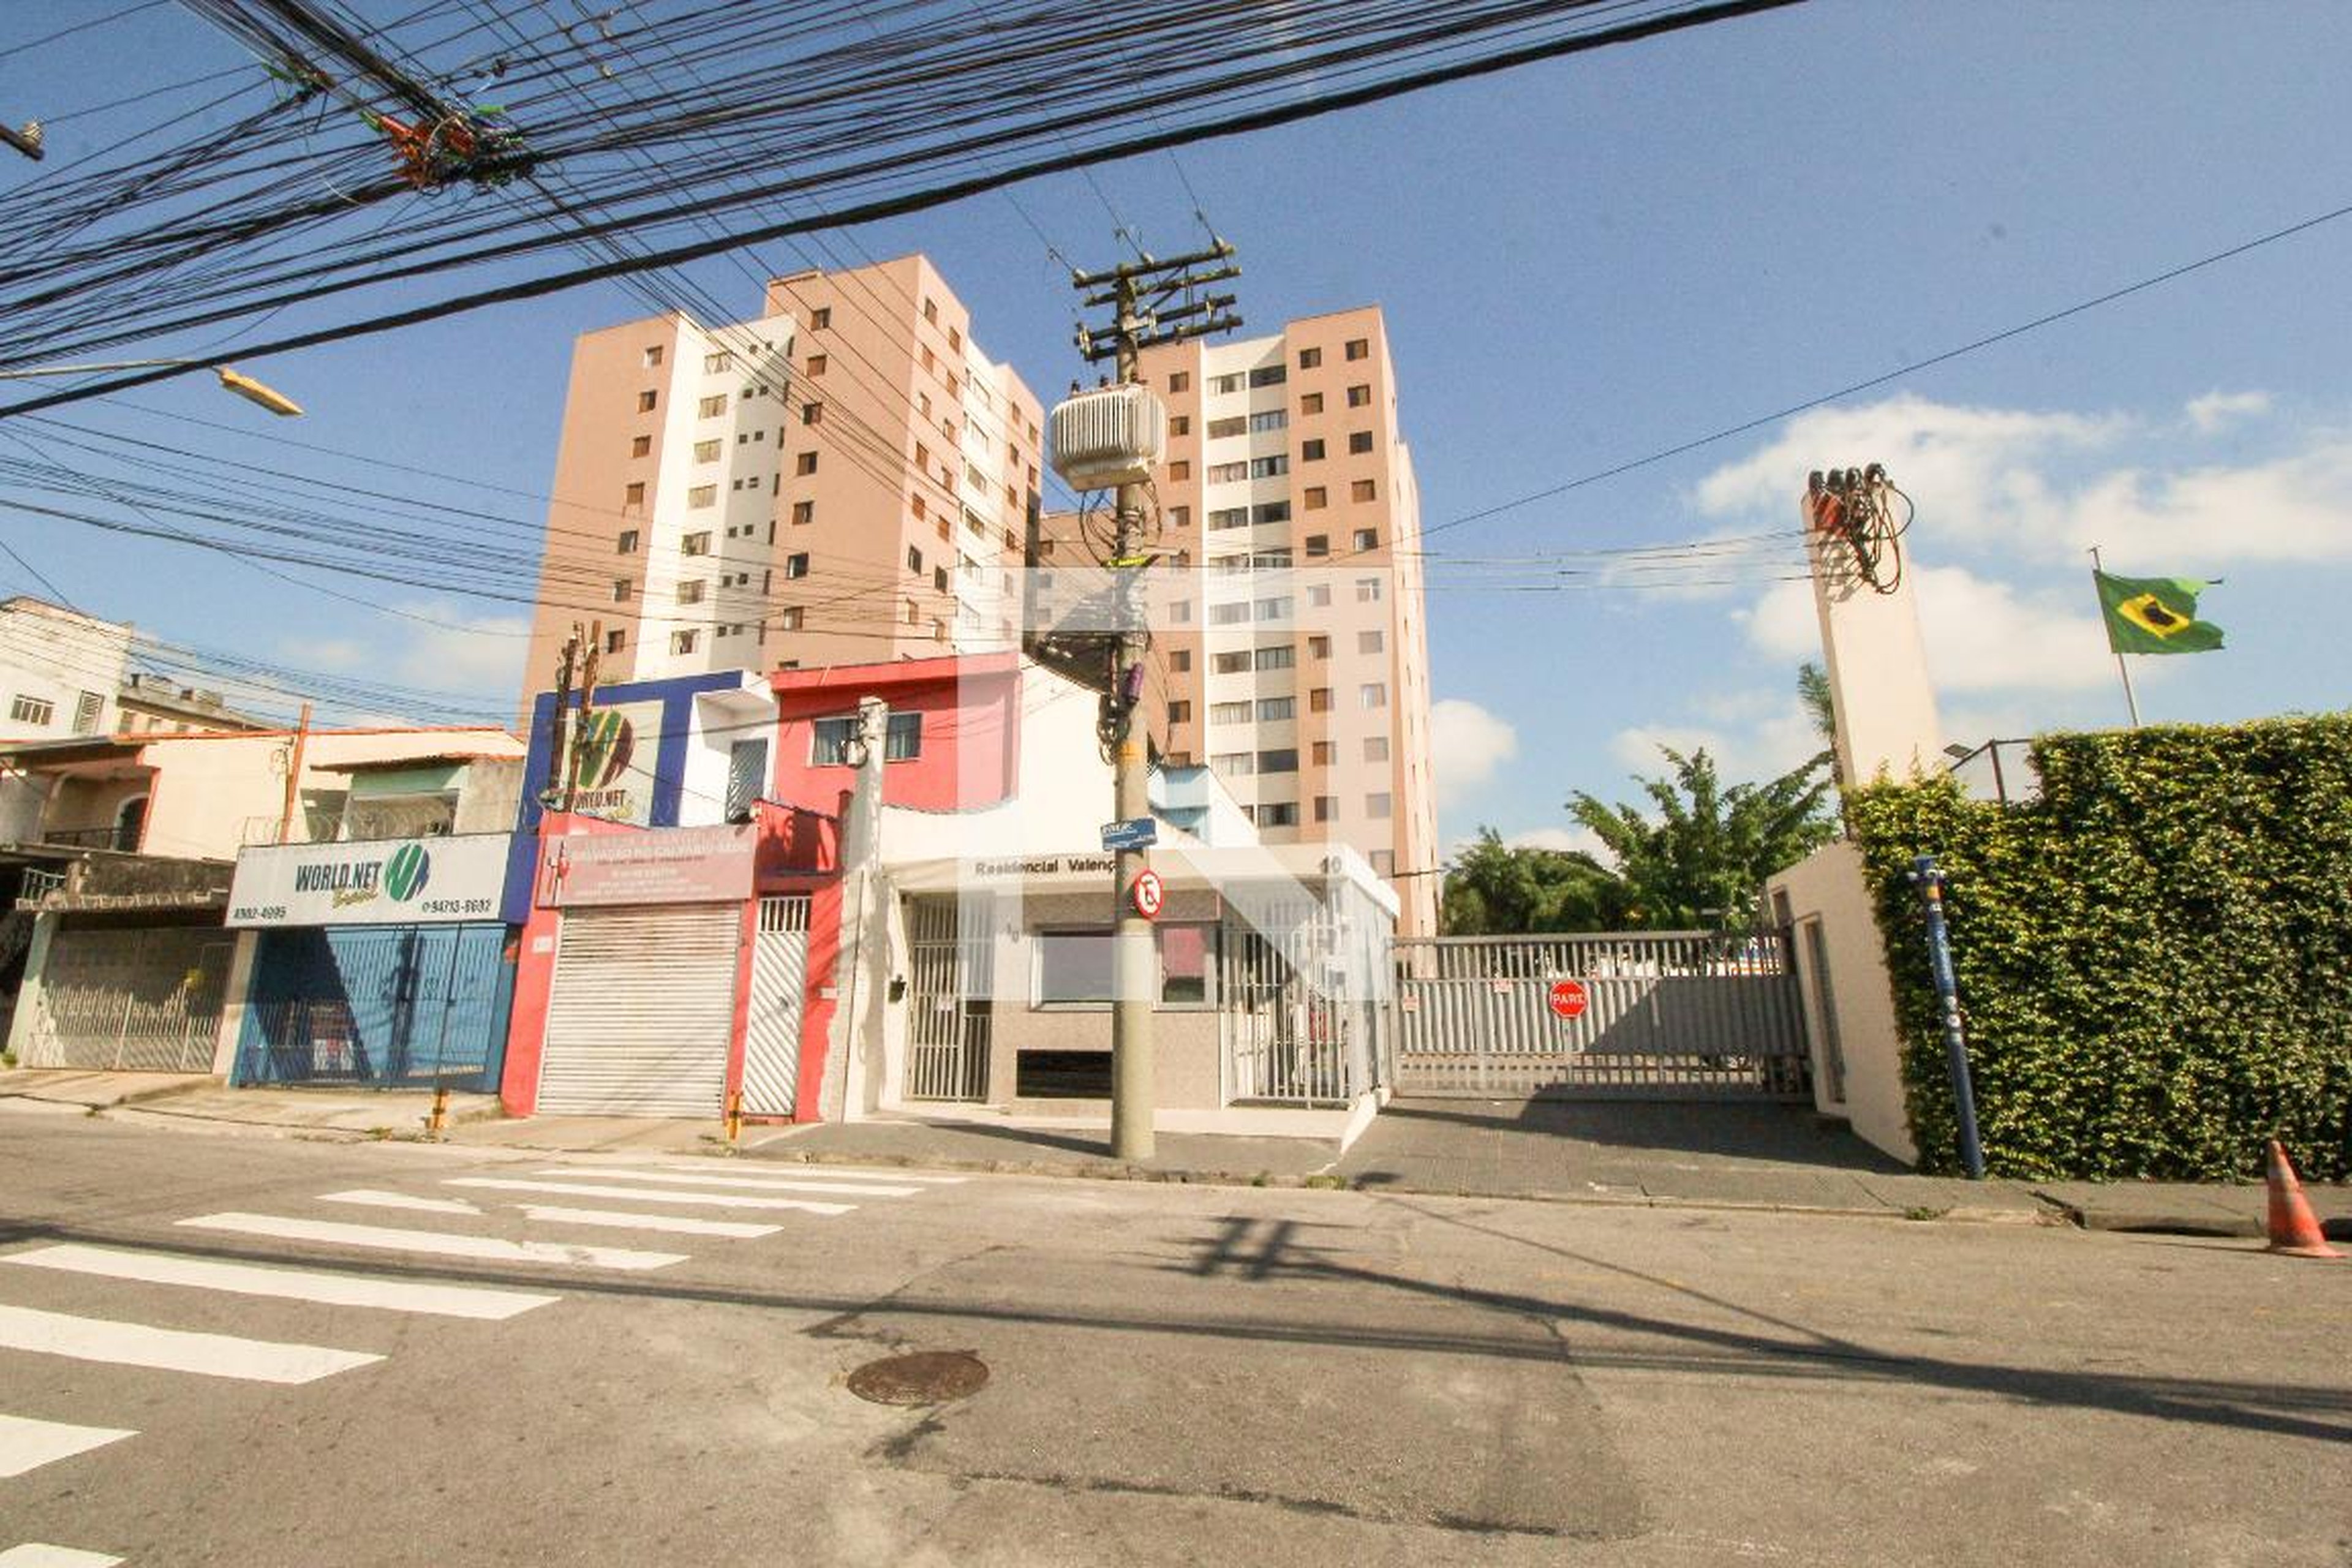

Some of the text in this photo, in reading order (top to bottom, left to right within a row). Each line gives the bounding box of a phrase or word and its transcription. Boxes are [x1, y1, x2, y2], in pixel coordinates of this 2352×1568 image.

[975, 859, 1116, 875] Residencial Valenç
[295, 861, 382, 892] WORLD.NET
[1553, 993, 1585, 1005] PARE
